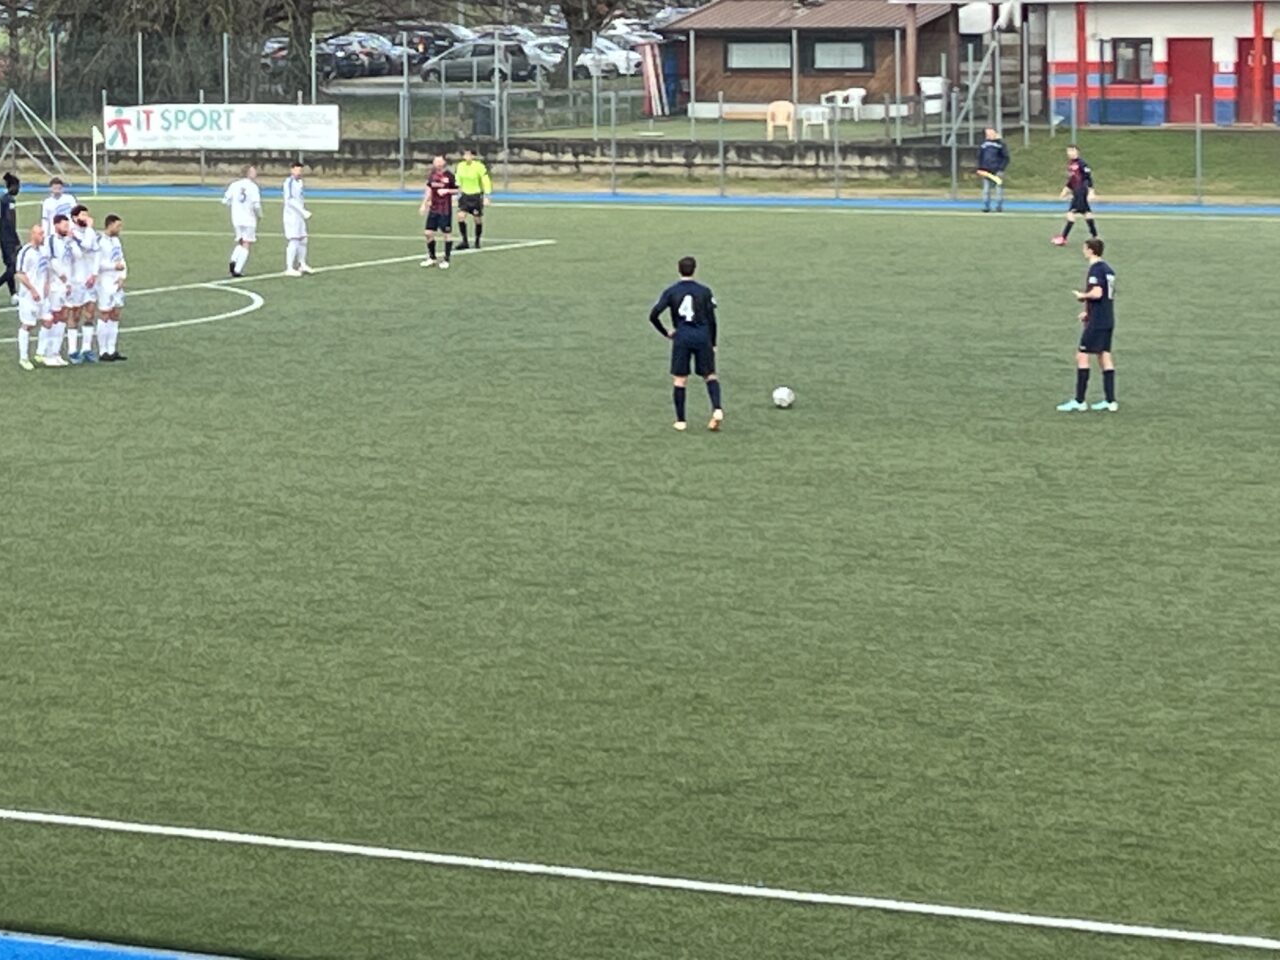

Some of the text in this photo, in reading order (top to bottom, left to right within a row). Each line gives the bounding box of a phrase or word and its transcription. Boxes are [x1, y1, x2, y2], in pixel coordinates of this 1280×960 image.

[136, 109, 154, 131] IT
[160, 108, 235, 131] SPORT
[678, 294, 695, 322] 4
